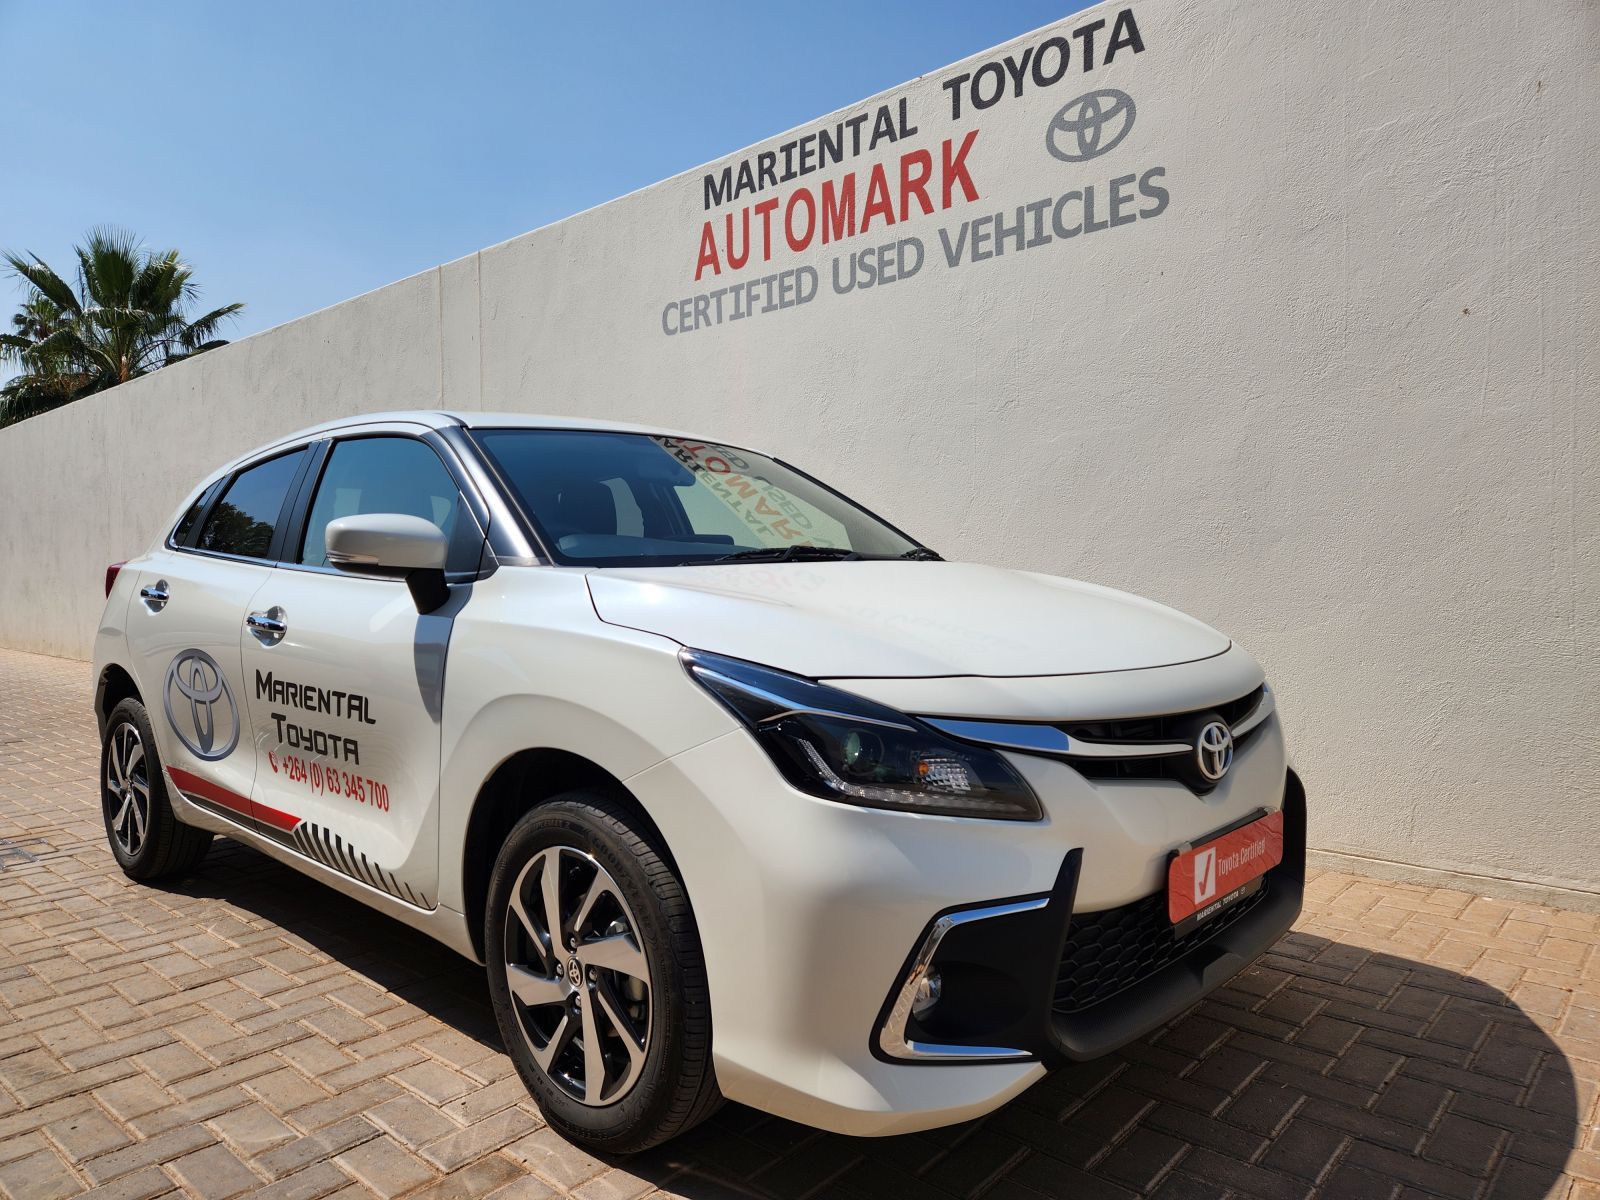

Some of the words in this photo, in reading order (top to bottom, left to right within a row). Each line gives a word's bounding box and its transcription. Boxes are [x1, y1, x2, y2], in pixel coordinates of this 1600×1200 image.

[704, 97, 918, 210] MARIENTAL
[943, 8, 1145, 120] TOYOTA
[662, 265, 818, 336] CERTIFIED
[832, 237, 925, 295] USED
[938, 167, 1170, 269] VEHICLES
[694, 129, 980, 281] AUTOMARK
[283, 755, 308, 784] +264
[309, 761, 324, 796] (0)
[326, 767, 341, 795] 63
[342, 771, 365, 803] 345
[367, 779, 389, 812] 700
[1196, 901, 1222, 921] MARIENTAL
[1223, 890, 1239, 905] TOYOTA
[1218, 853, 1239, 877] Toyota
[1240, 837, 1266, 865] Certified
